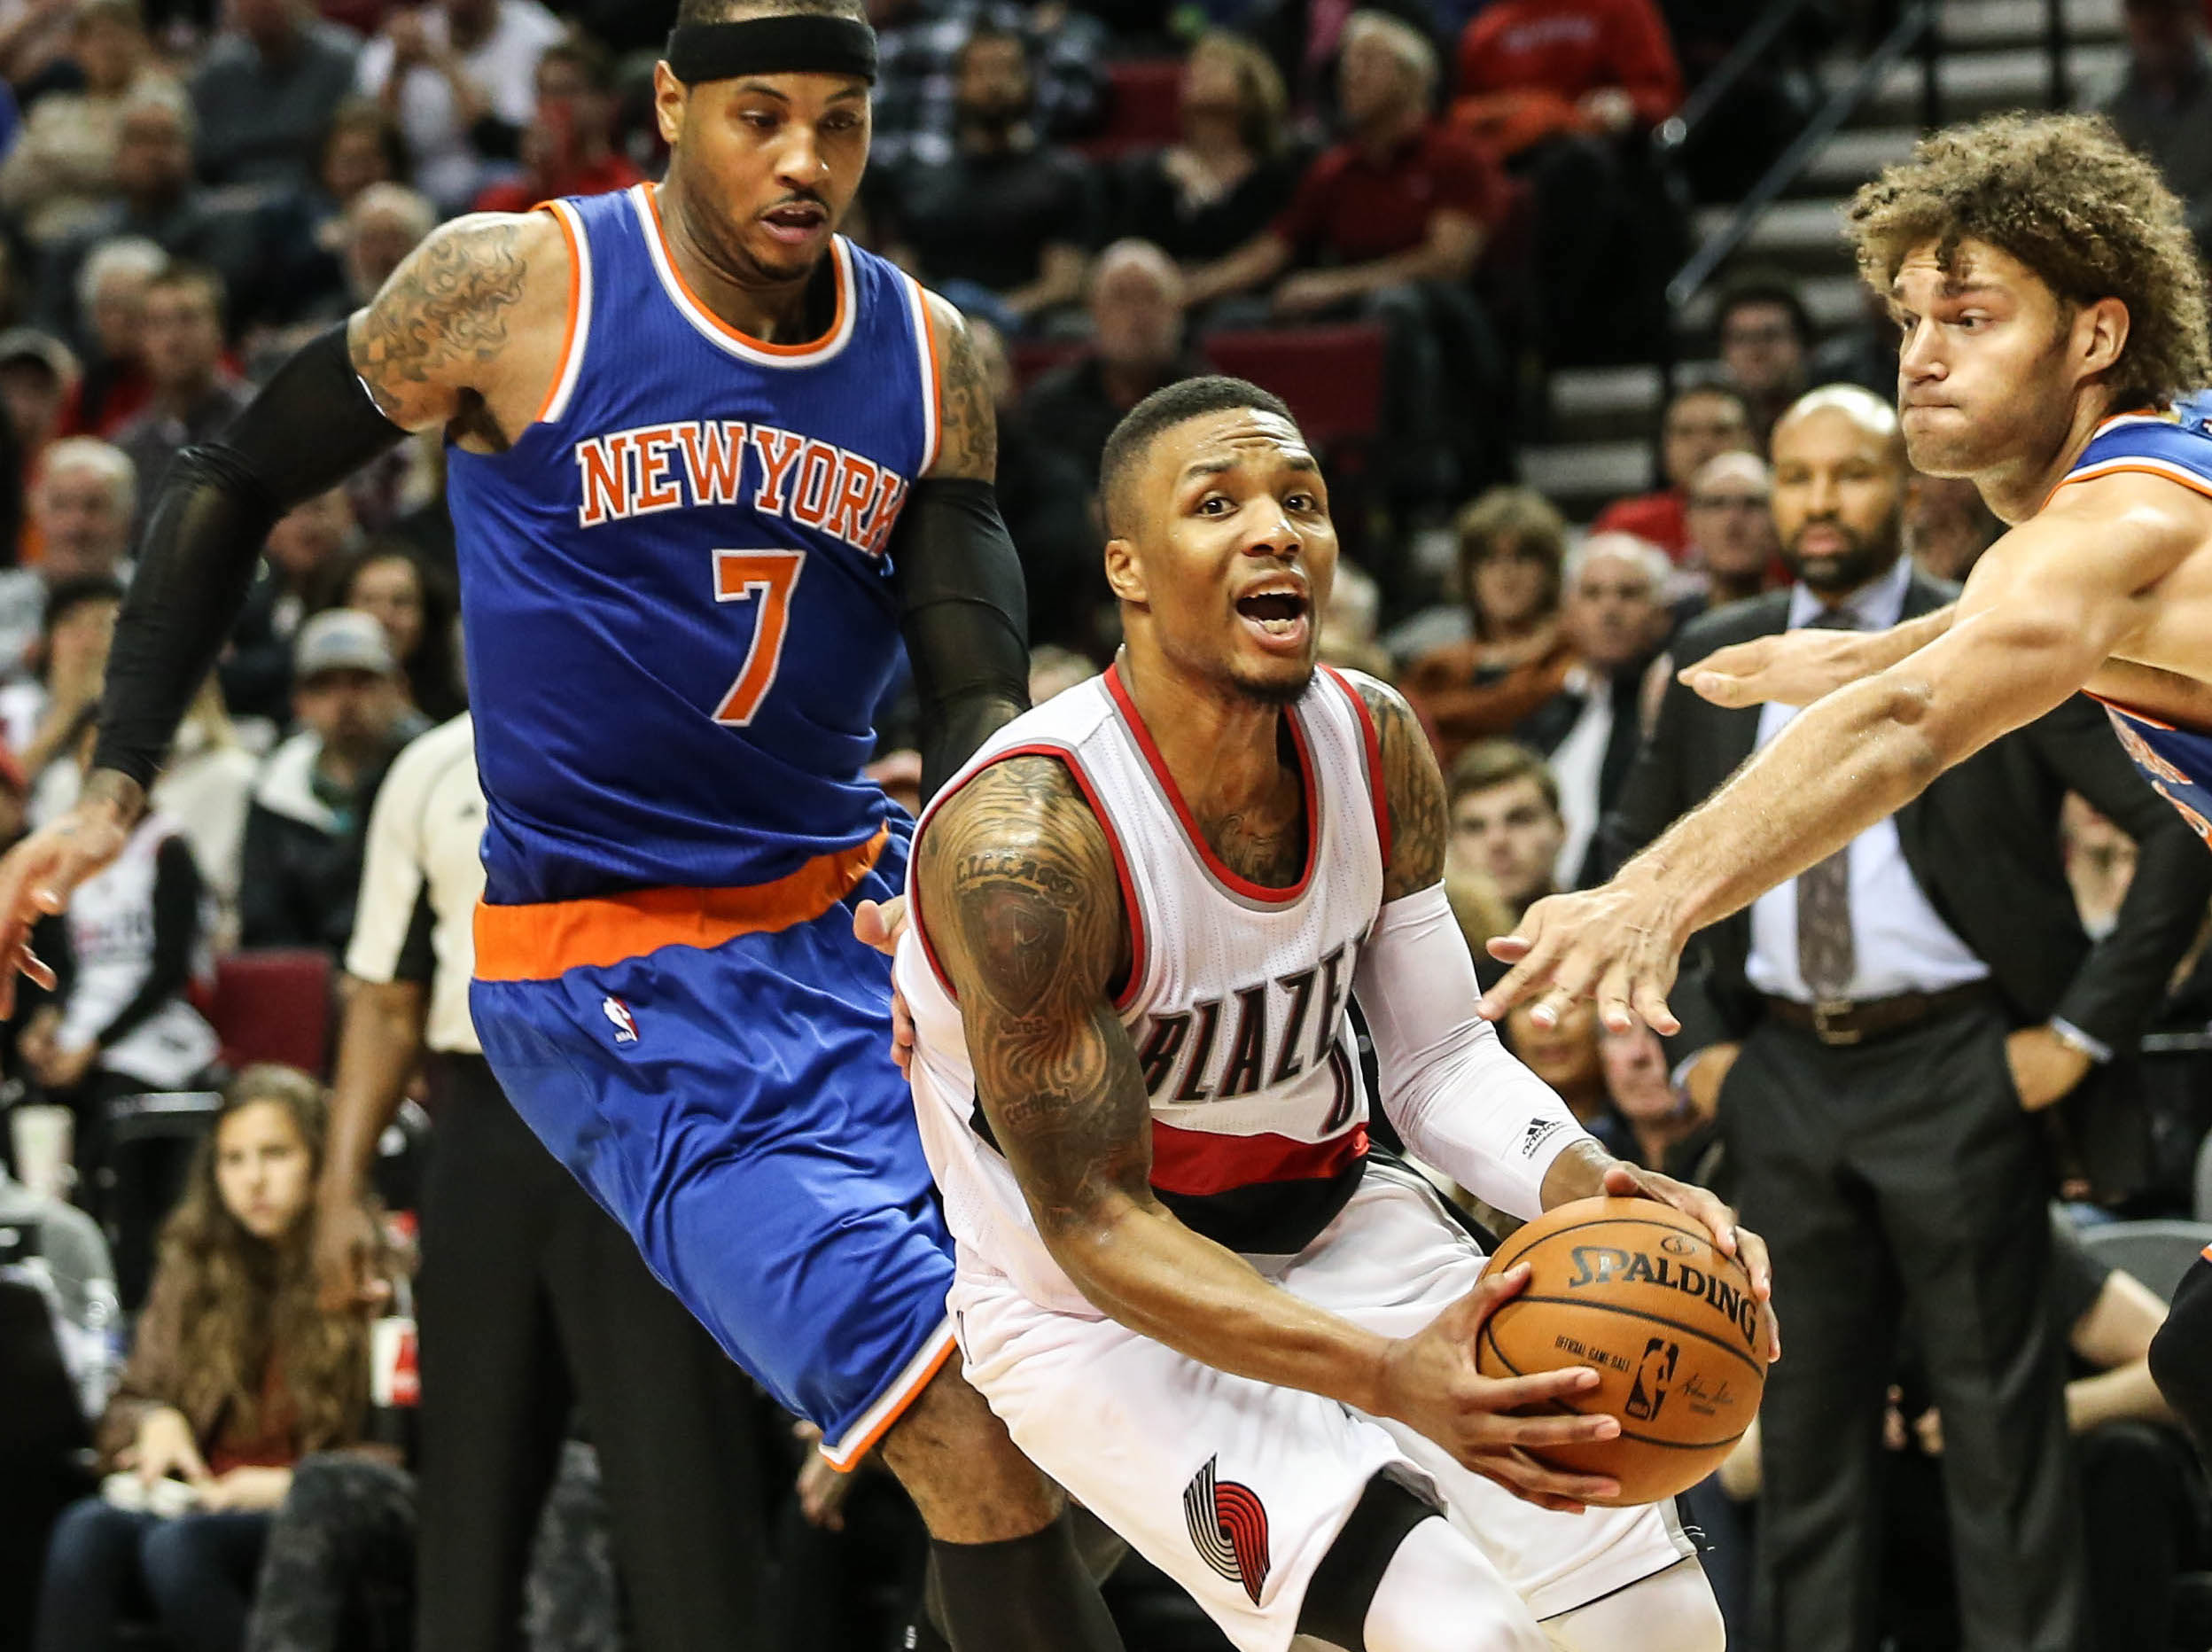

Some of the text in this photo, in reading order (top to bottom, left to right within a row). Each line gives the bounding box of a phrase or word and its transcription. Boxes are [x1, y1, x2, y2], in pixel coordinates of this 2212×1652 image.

[575, 420, 910, 558] NEW YORK
[712, 549, 806, 727] 7
[1138, 922, 1370, 1104] BLAZE
[1554, 1335, 1631, 1374] OFFICIAL GAME BALL
[1569, 1245, 1756, 1346] SPALDING
